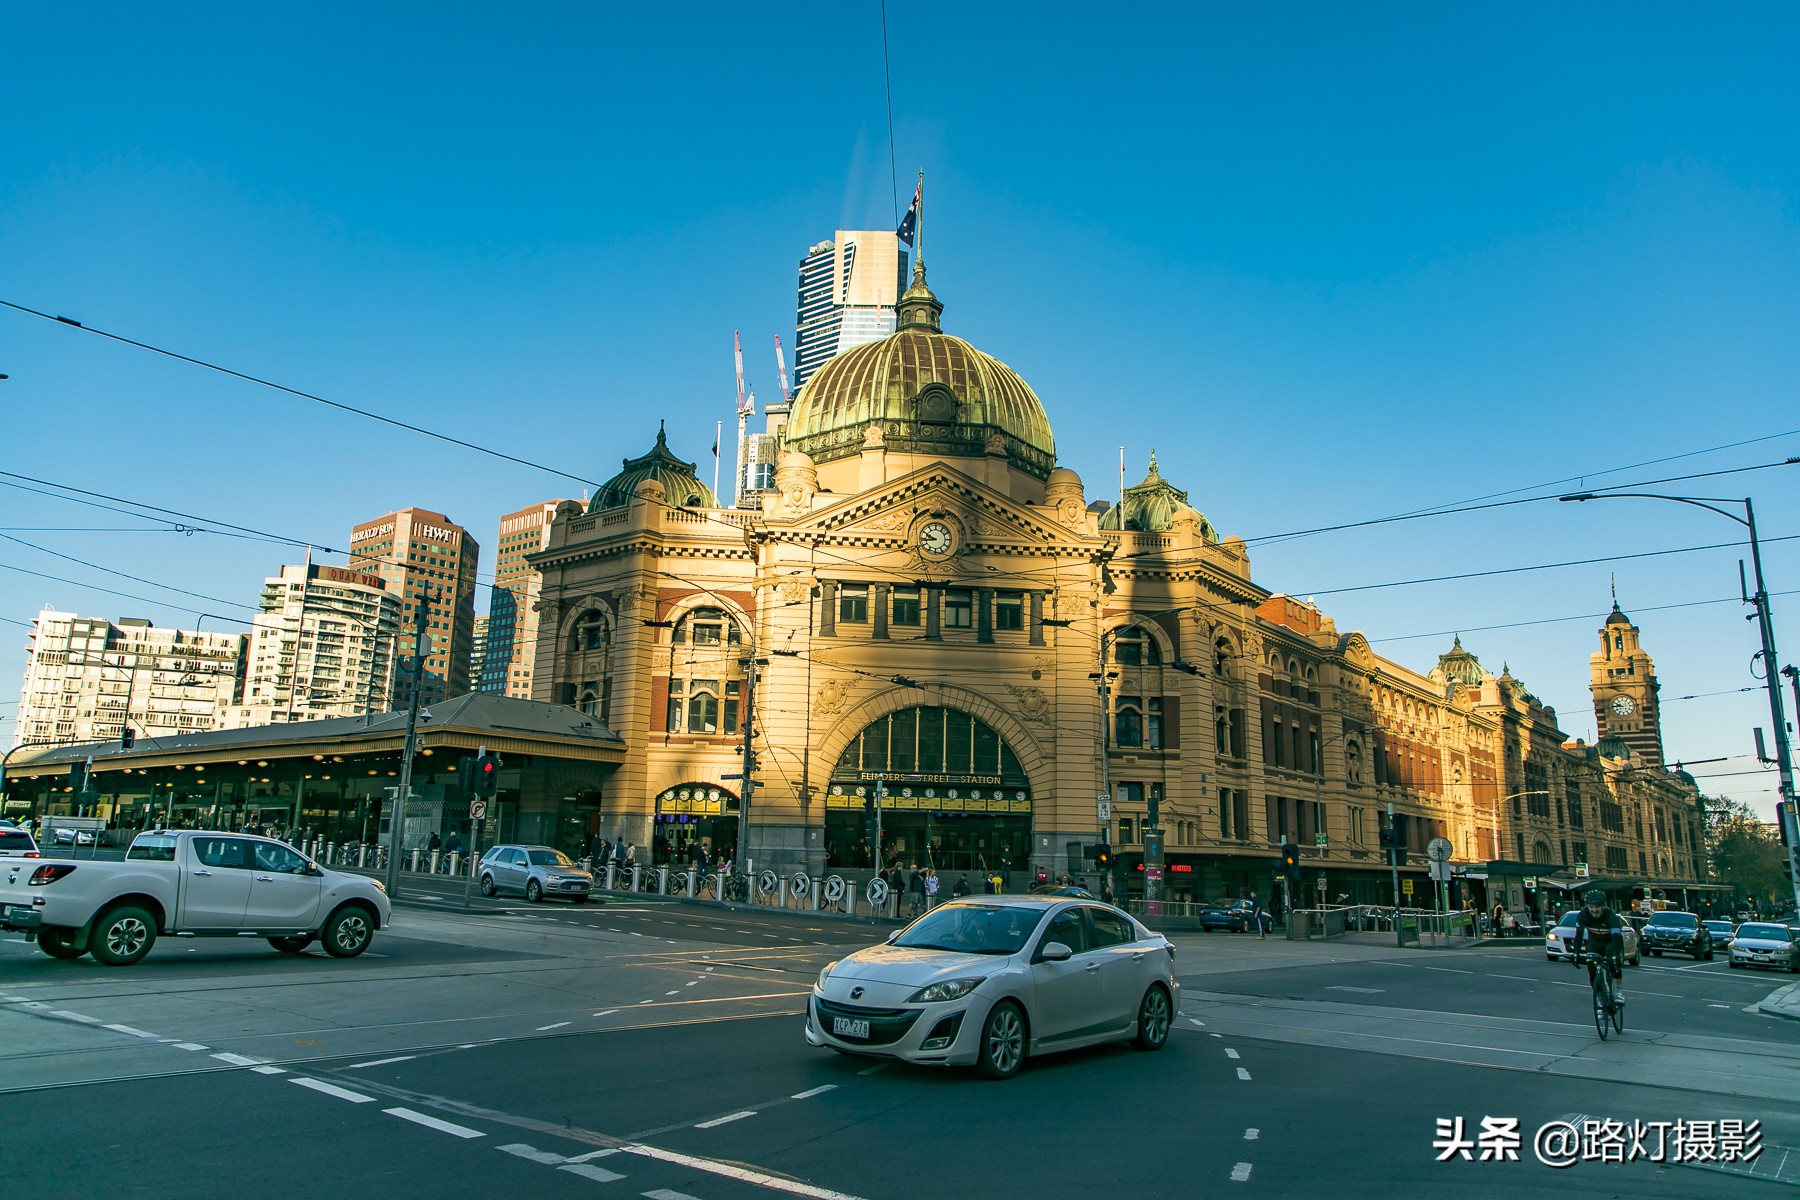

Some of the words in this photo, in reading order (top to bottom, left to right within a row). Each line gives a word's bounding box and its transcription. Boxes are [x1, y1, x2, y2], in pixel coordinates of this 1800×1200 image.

[351, 525, 378, 543] HERALD
[379, 521, 396, 538] SUN
[423, 524, 452, 543] HWT
[331, 569, 357, 582] QUAY
[917, 774, 950, 783] STREET
[961, 776, 1001, 785] STATION
[853, 1020, 868, 1034] 278
